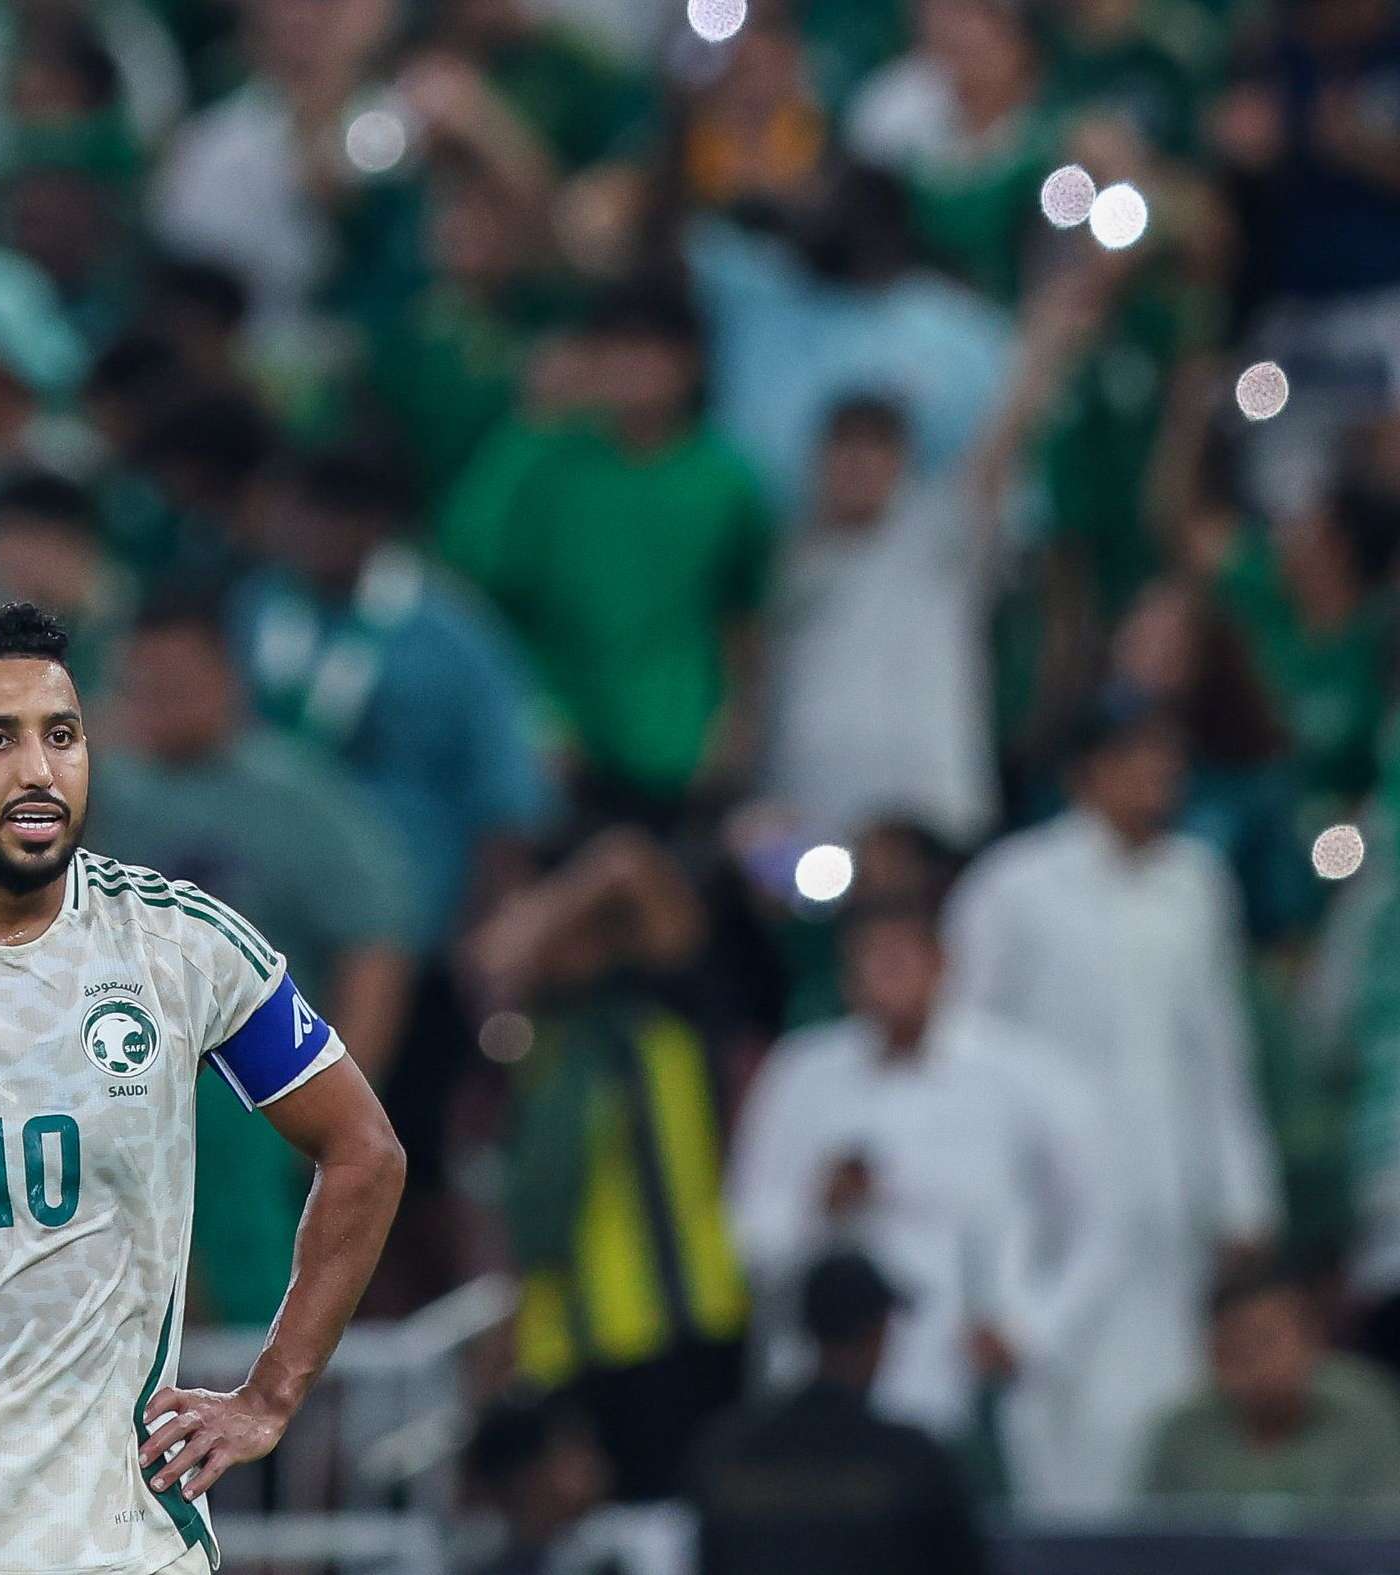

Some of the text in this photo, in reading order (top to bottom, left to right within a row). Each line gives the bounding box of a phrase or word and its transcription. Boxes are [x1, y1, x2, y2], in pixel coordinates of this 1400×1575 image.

[84, 981, 143, 997] السعودية
[124, 1044, 146, 1053] SAFF
[108, 1085, 148, 1097] SAUDI
